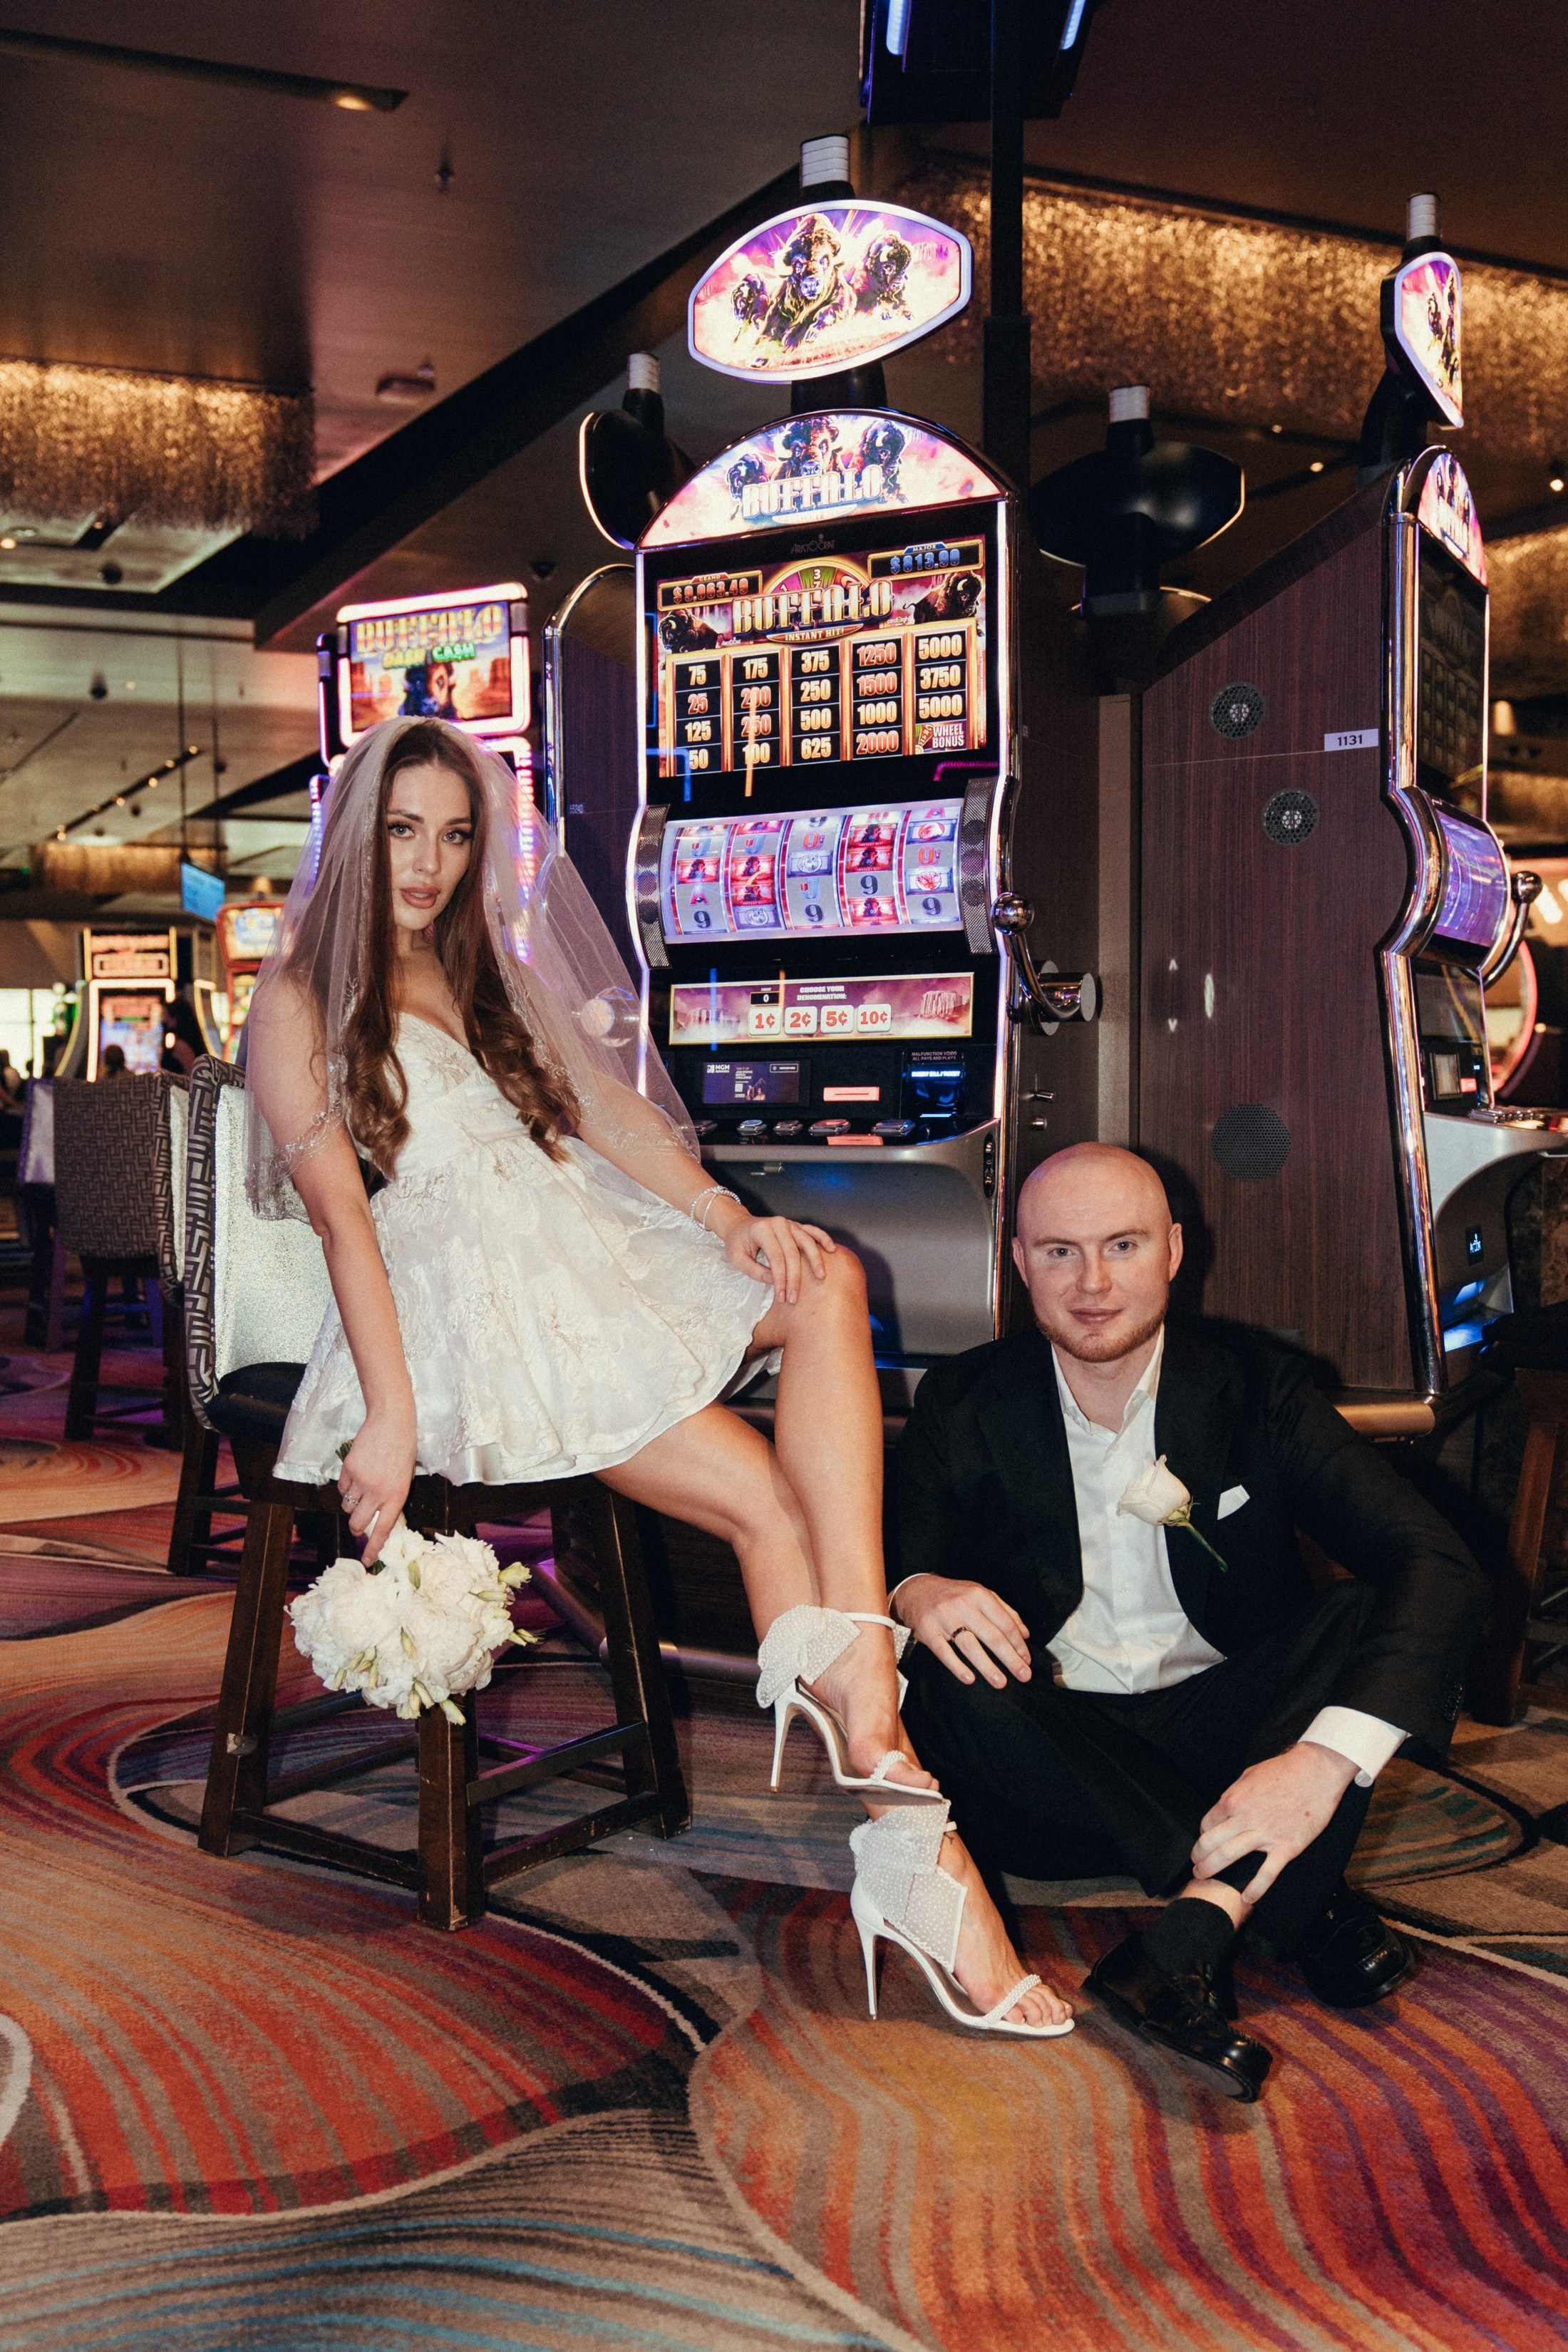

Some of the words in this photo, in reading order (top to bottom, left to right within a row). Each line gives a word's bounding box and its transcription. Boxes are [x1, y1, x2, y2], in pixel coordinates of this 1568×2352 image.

[743, 464, 884, 519] BUFFALO
[890, 548, 960, 574] $813.90
[673, 578, 748, 604] $9,063.49
[733, 579, 895, 635] BUFFALO
[785, 631, 823, 641] INSTANT
[825, 627, 845, 637] HIT!
[688, 664, 706, 686] 75
[743, 657, 768, 679] 175
[801, 649, 830, 673] 375
[857, 642, 897, 666] 1250
[918, 634, 962, 660] 5000
[688, 693, 708, 714] 25
[741, 686, 771, 709] 200
[800, 679, 831, 702] 250
[857, 671, 897, 696] 1500
[920, 664, 961, 689] 3750
[685, 720, 711, 742] 125
[741, 714, 771, 737] 250
[800, 708, 832, 731] 500
[857, 701, 897, 725] 1000
[919, 694, 963, 719] 5000
[933, 723, 964, 737] WHEEL
[932, 735, 964, 748] BONUS
[1337, 734, 1363, 746] 1131
[689, 748, 708, 770] 50
[743, 743, 770, 765] 100
[801, 736, 831, 760] 625
[856, 730, 899, 755] 2000
[917, 846, 938, 865] Q
[860, 875, 878, 894] 9
[689, 885, 709, 905] A
[805, 904, 823, 922] 9
[922, 897, 942, 916] 9
[693, 909, 711, 928] 9
[763, 994, 769, 1003] 0
[755, 1013, 775, 1028] 1¢
[790, 1011, 811, 1028] 2¢
[825, 1011, 847, 1026] 5¢
[860, 1010, 888, 1025] 10¢
